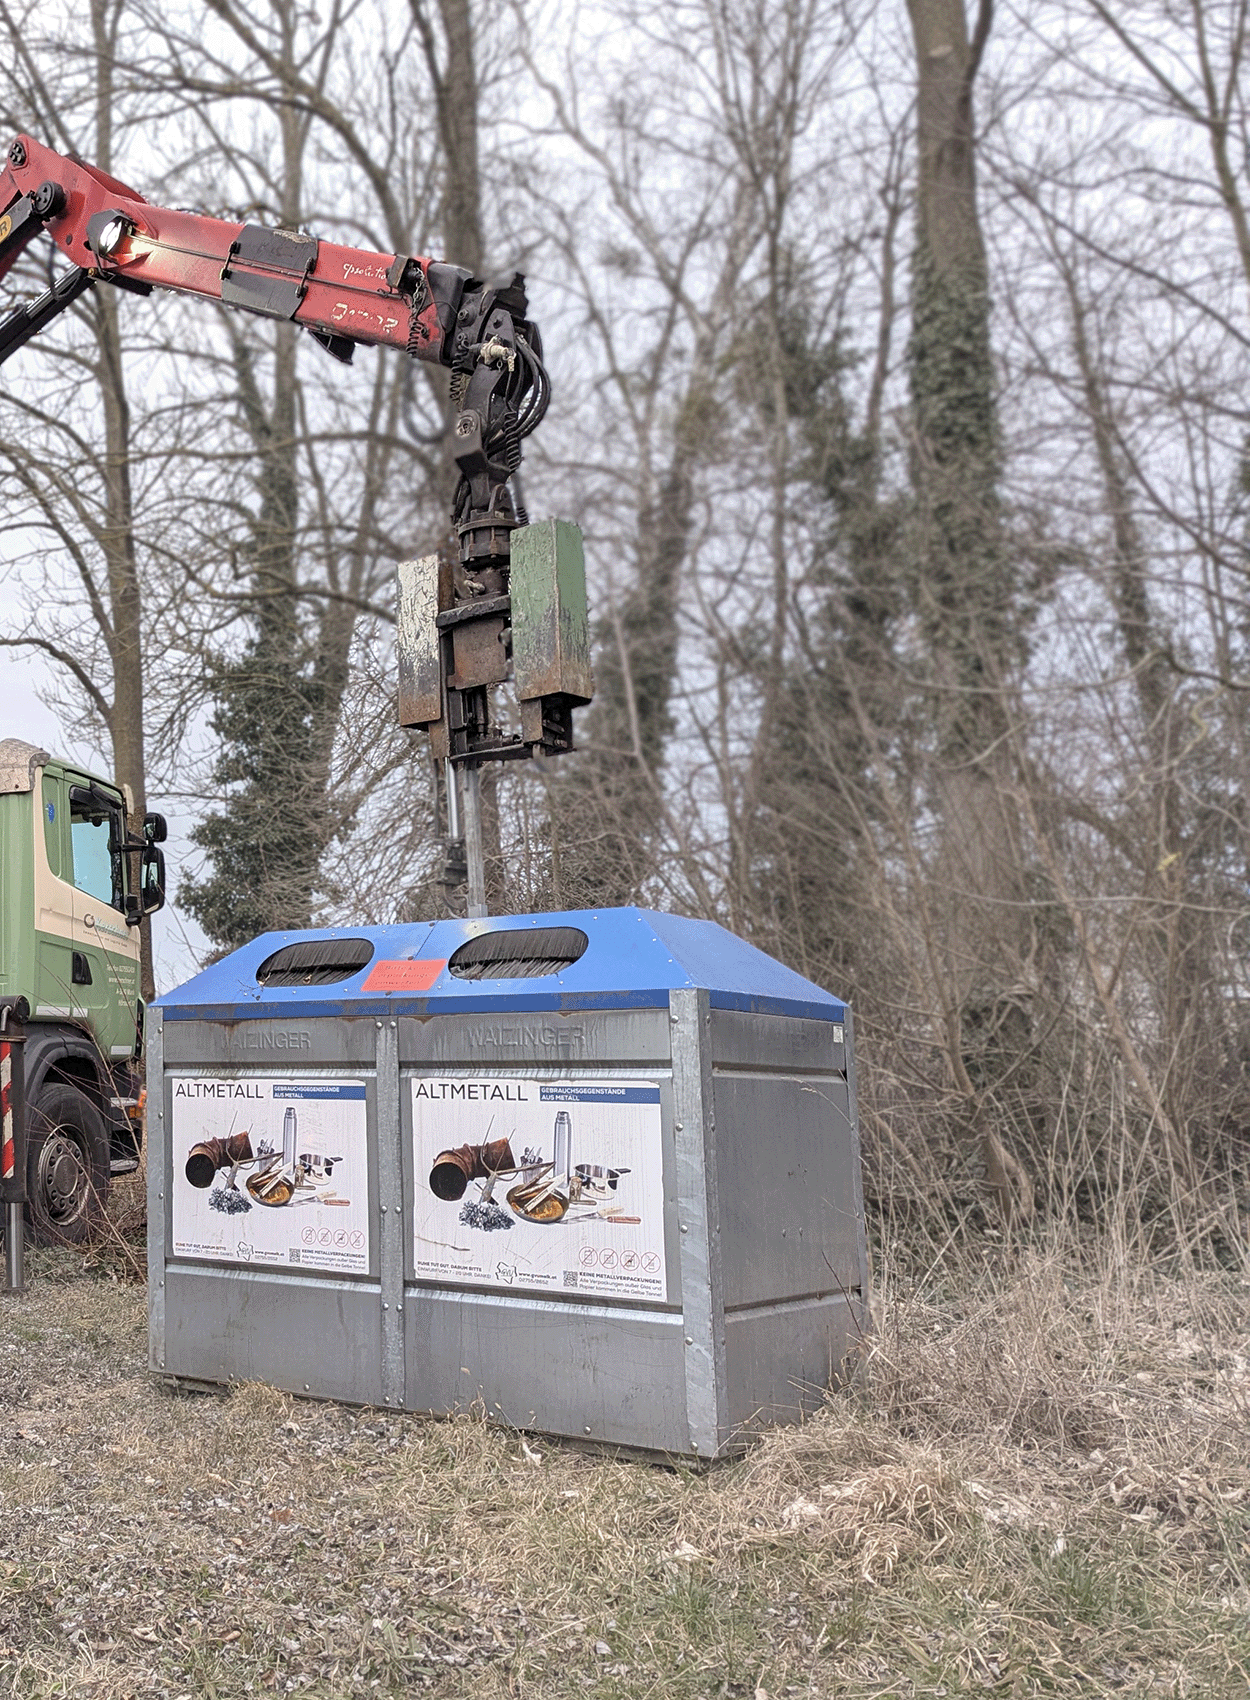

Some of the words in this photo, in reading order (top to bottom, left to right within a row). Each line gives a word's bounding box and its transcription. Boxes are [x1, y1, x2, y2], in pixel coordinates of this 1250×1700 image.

[467, 1025, 586, 1046] WAIZINGER
[175, 1083, 264, 1099] ALTMETALL
[415, 1083, 528, 1101] ALTMETALL
[541, 1087, 626, 1095] GEBRAUCHSGEGENSTÄNDE
[590, 1279, 624, 1287] Verpackungen
[596, 1273, 662, 1284] METALLVERPACKUNGEN!
